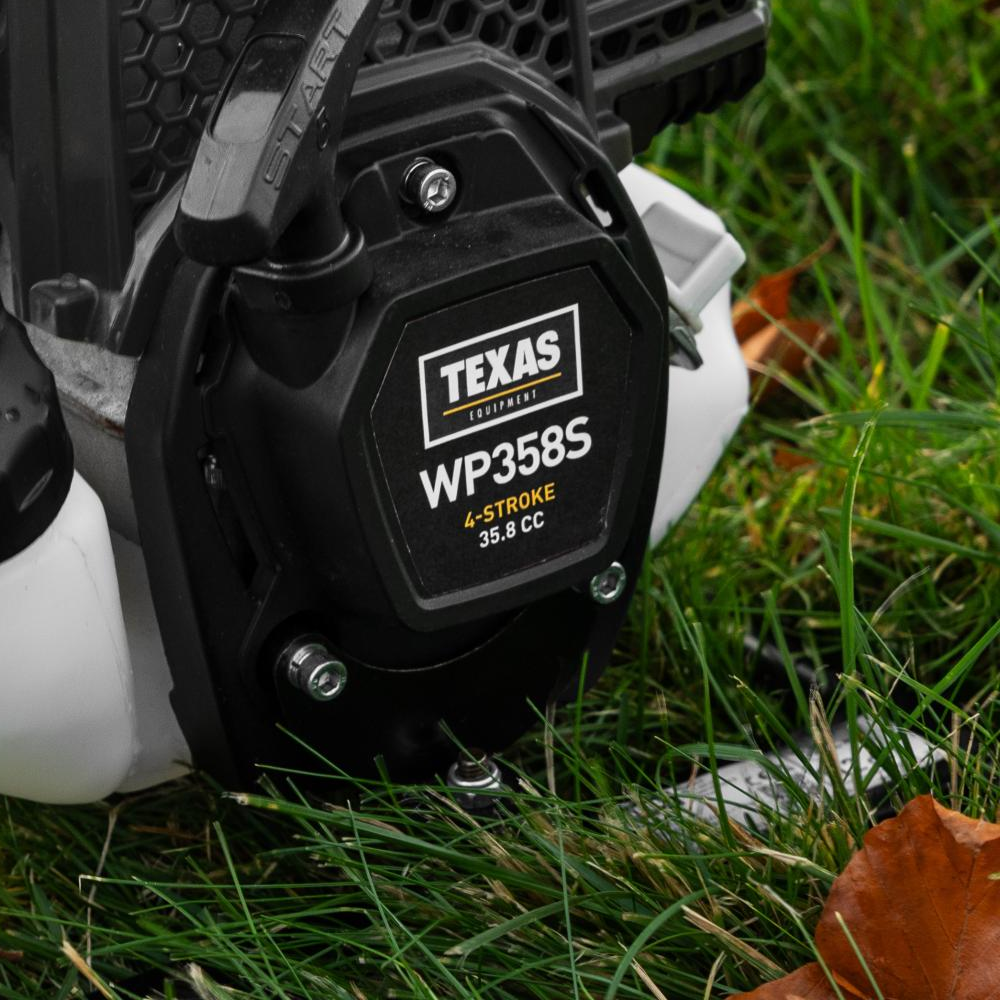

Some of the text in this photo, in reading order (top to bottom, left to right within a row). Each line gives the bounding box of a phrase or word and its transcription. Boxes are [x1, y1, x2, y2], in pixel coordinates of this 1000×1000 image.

[264, 9, 350, 190] START
[440, 330, 561, 404] TEXAS
[469, 389, 538, 421] EQUIPMENT
[420, 416, 592, 509] WP358S
[464, 482, 556, 529] 4-STROKE
[479, 511, 545, 548] 35.8 CC
